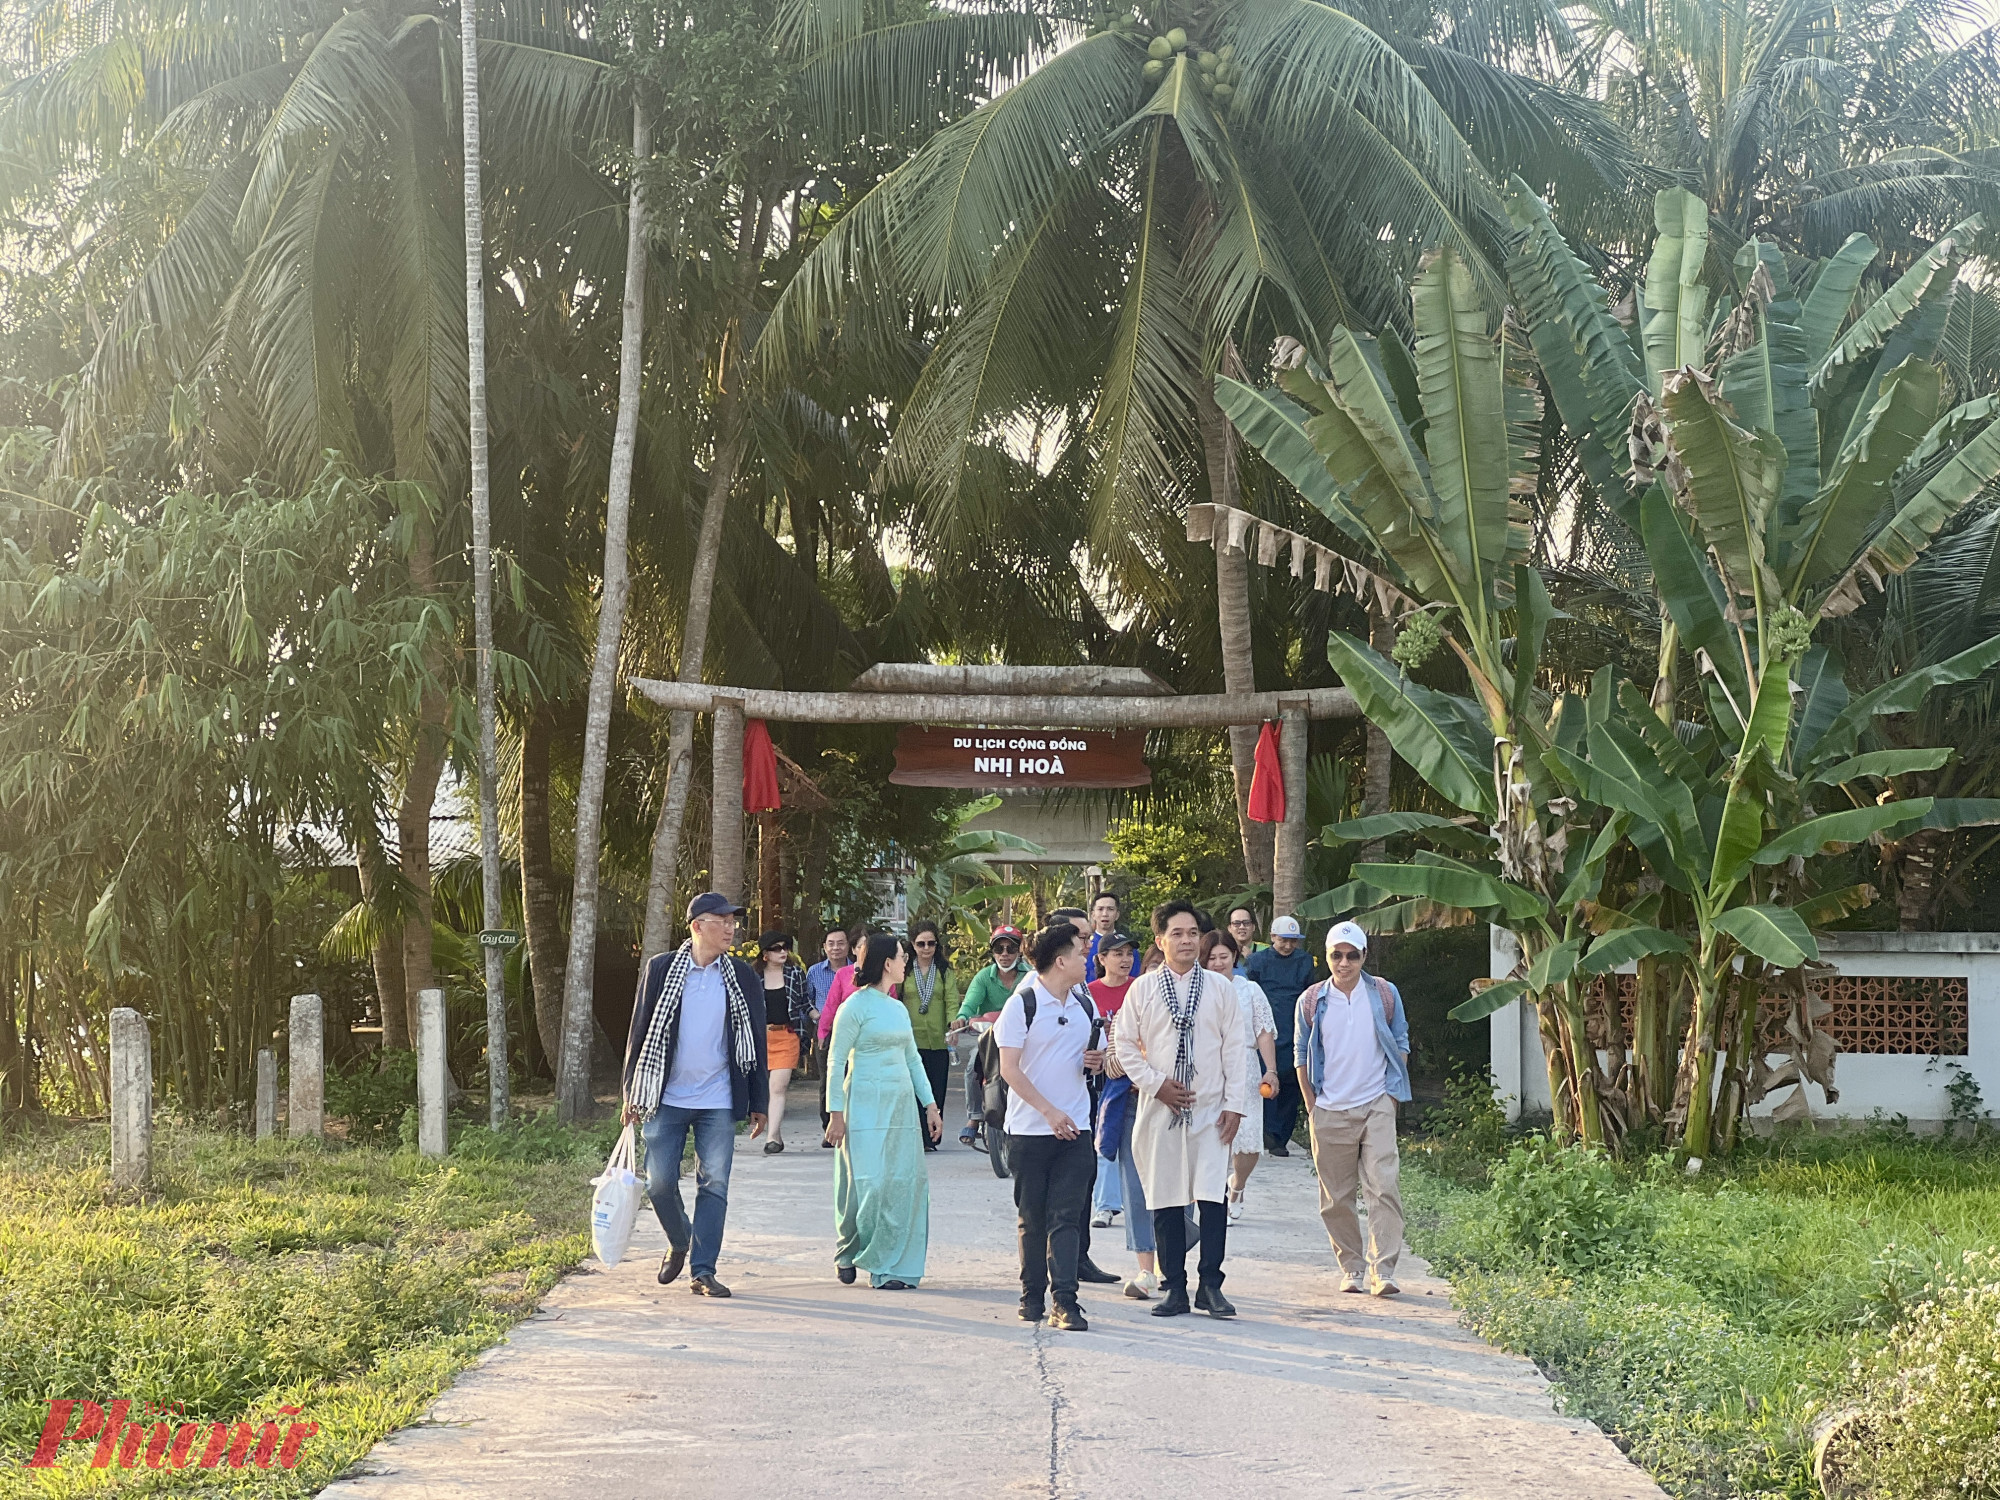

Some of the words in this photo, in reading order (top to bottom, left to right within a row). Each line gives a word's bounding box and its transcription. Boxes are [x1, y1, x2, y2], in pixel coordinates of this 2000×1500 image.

[953, 738, 972, 748] DU
[975, 739, 1006, 751] LỊCH
[1008, 737, 1046, 752] CỘNG
[1049, 736, 1087, 751] ĐỒNG
[974, 757, 1012, 777] NHỊ
[1019, 755, 1065, 775] HOÀ
